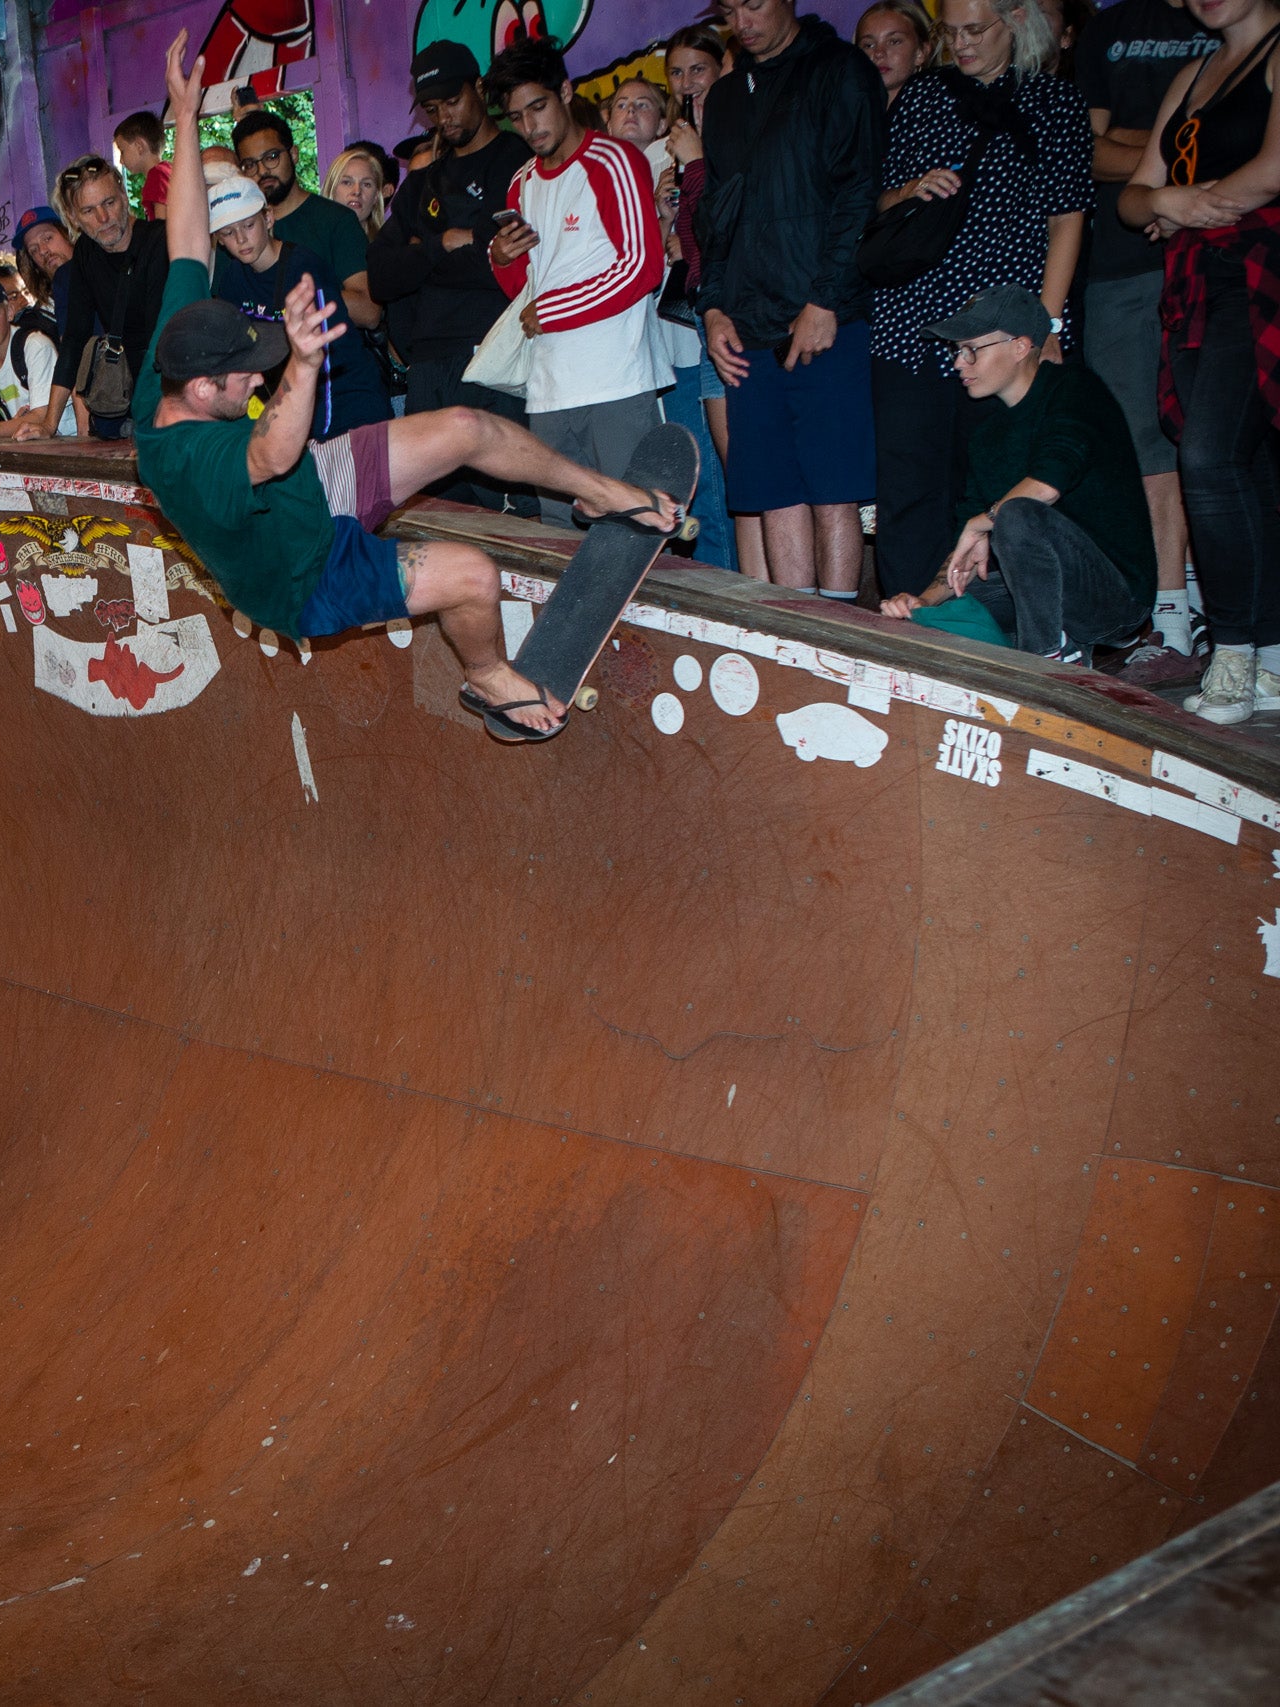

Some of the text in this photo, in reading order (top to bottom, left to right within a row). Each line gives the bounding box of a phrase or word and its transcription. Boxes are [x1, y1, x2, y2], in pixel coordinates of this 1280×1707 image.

[19, 542, 39, 562] ANTI
[97, 544, 124, 564] HERO
[943, 718, 1002, 759] SKIZO
